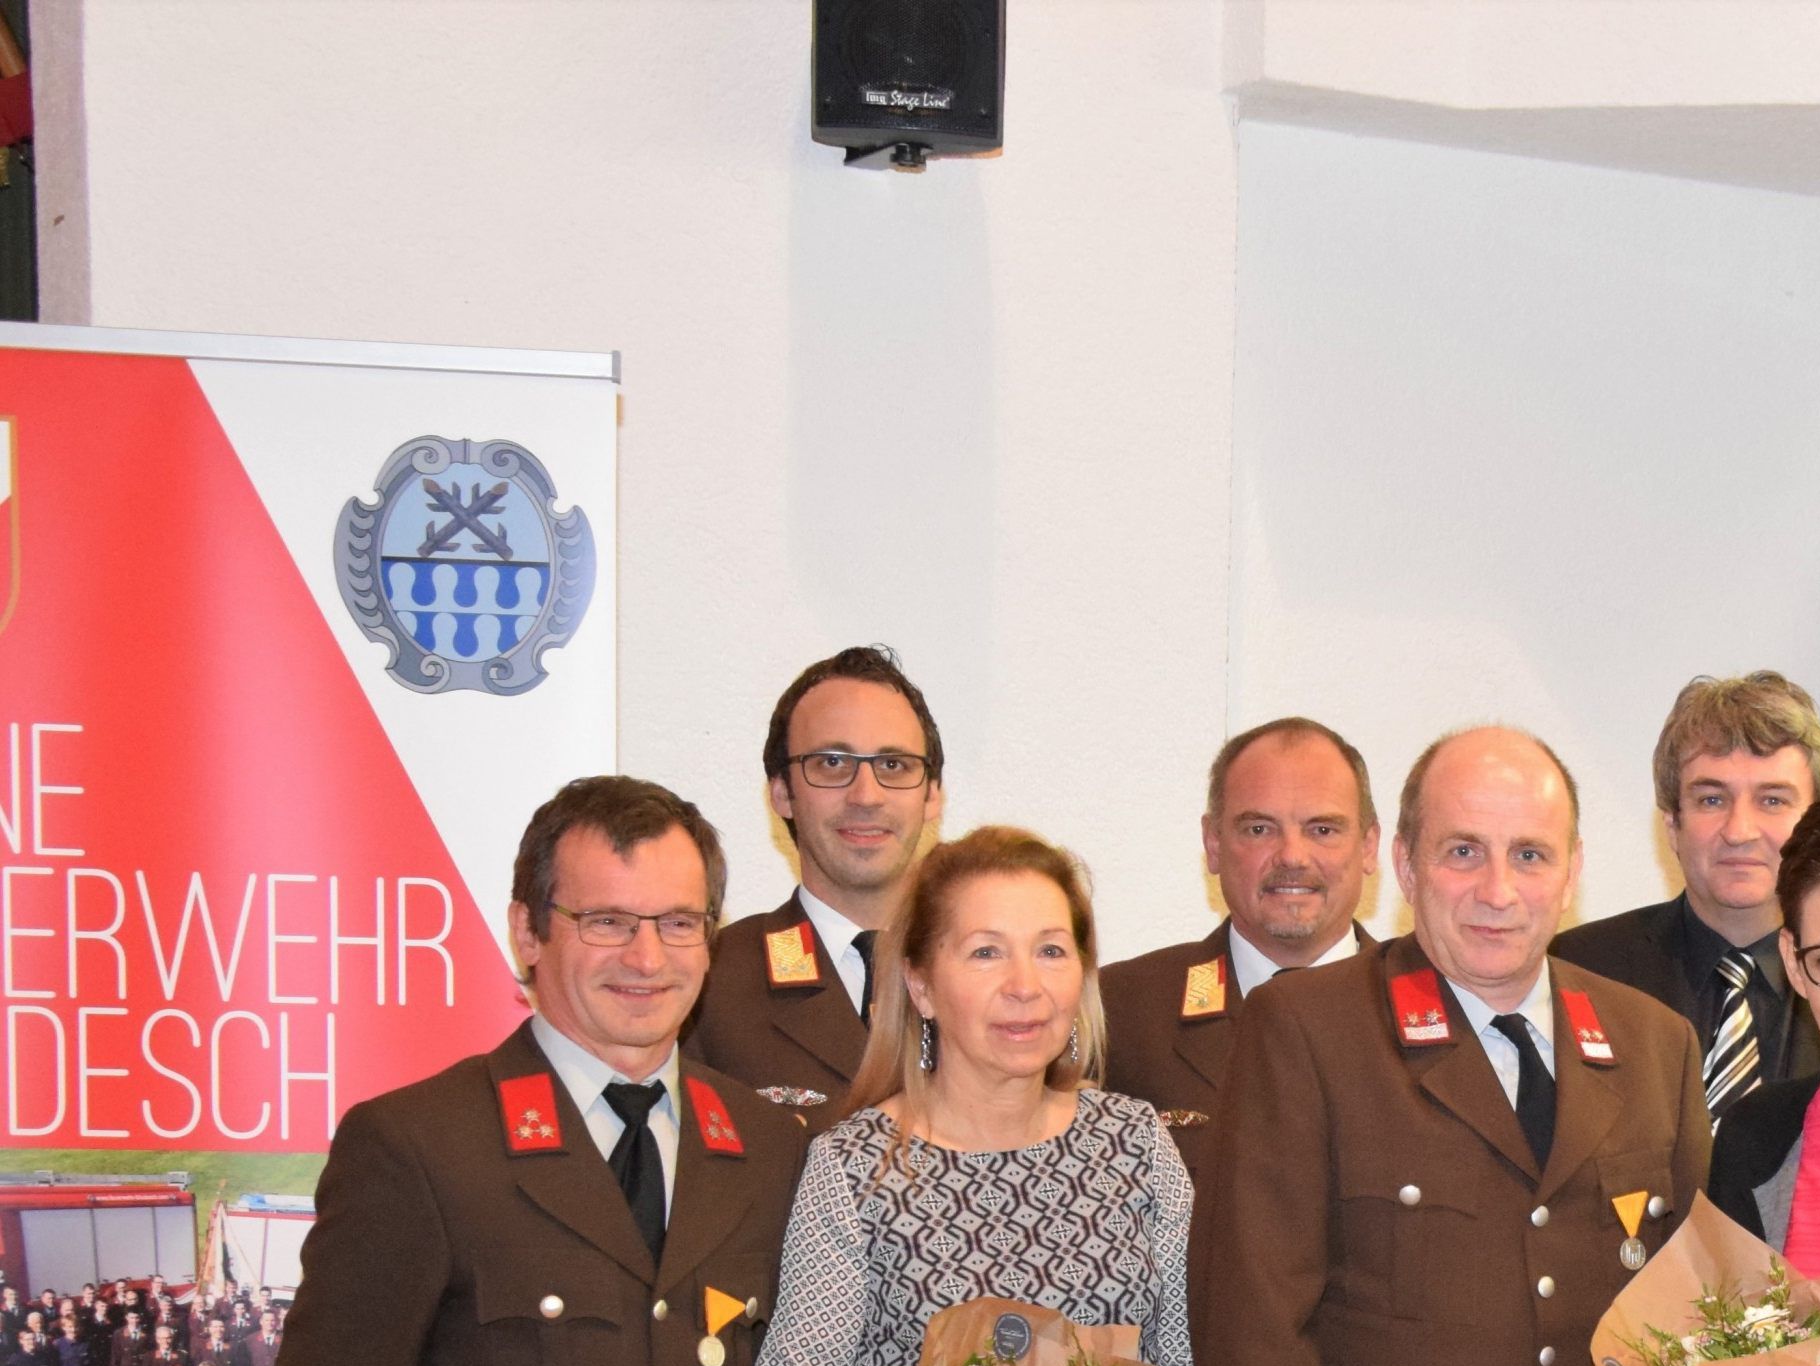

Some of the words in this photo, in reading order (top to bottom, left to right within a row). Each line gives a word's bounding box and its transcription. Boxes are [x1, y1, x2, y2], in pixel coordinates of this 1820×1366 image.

[891, 90, 920, 111] Stage
[923, 92, 949, 107] Line
[2, 866, 455, 1007] ERWEHR
[7, 1004, 335, 1141] DESCH
